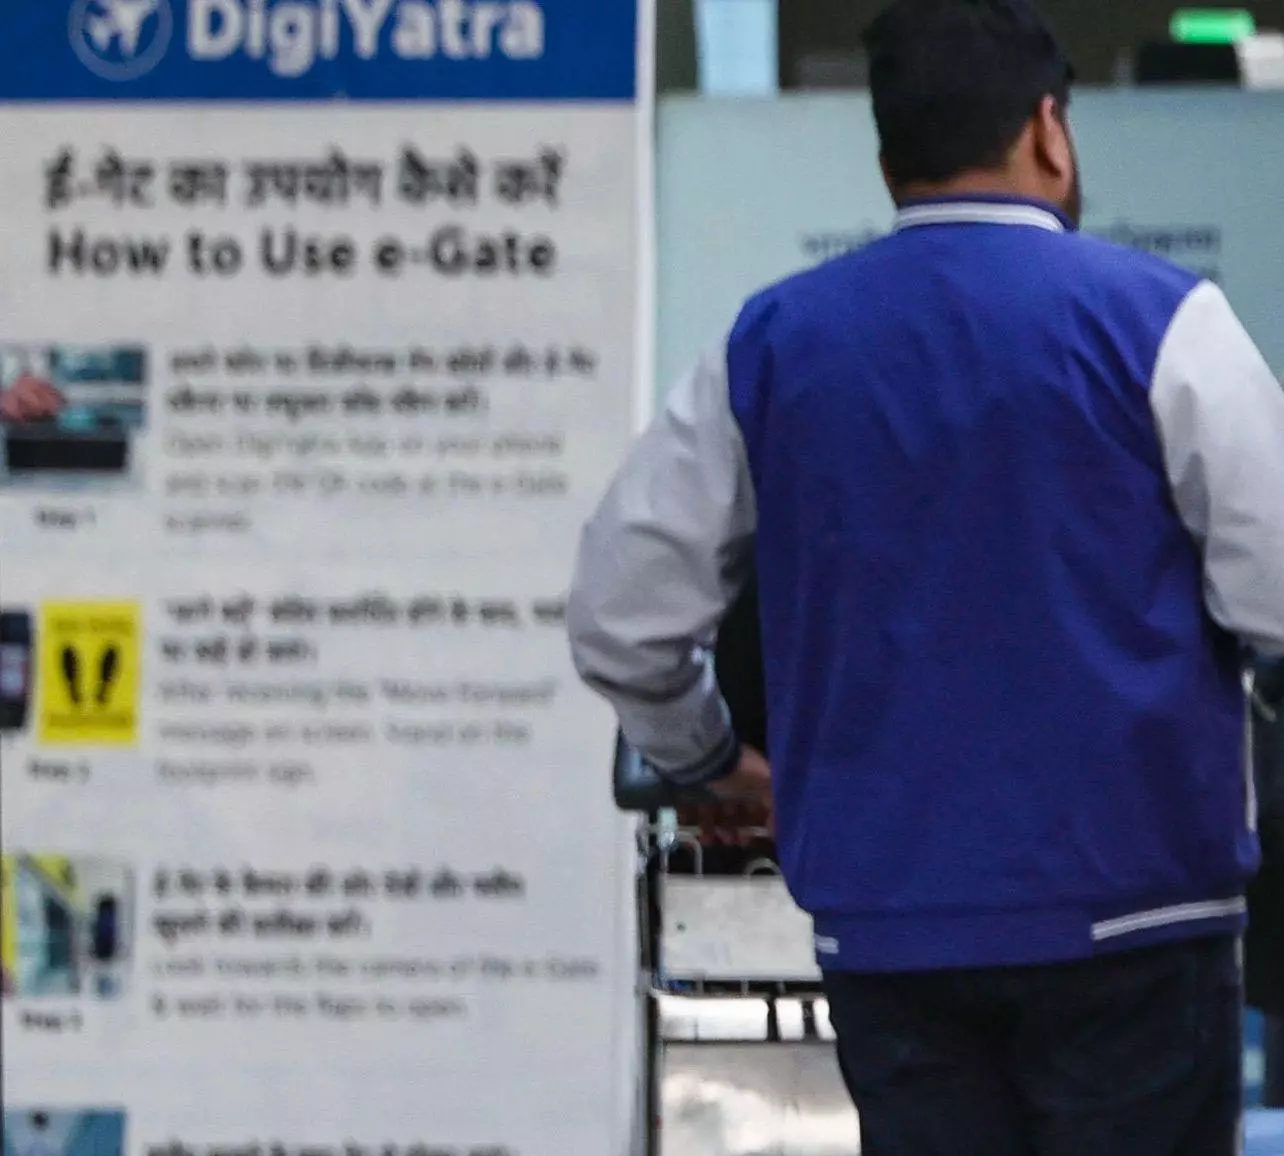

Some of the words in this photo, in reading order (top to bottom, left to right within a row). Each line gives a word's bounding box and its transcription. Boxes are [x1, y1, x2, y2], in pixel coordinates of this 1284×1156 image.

[187, 0, 545, 77] DigiYatra
[47, 230, 168, 276] How
[186, 233, 242, 276] to
[258, 230, 357, 276] Use
[372, 226, 557, 277] e-Gate
